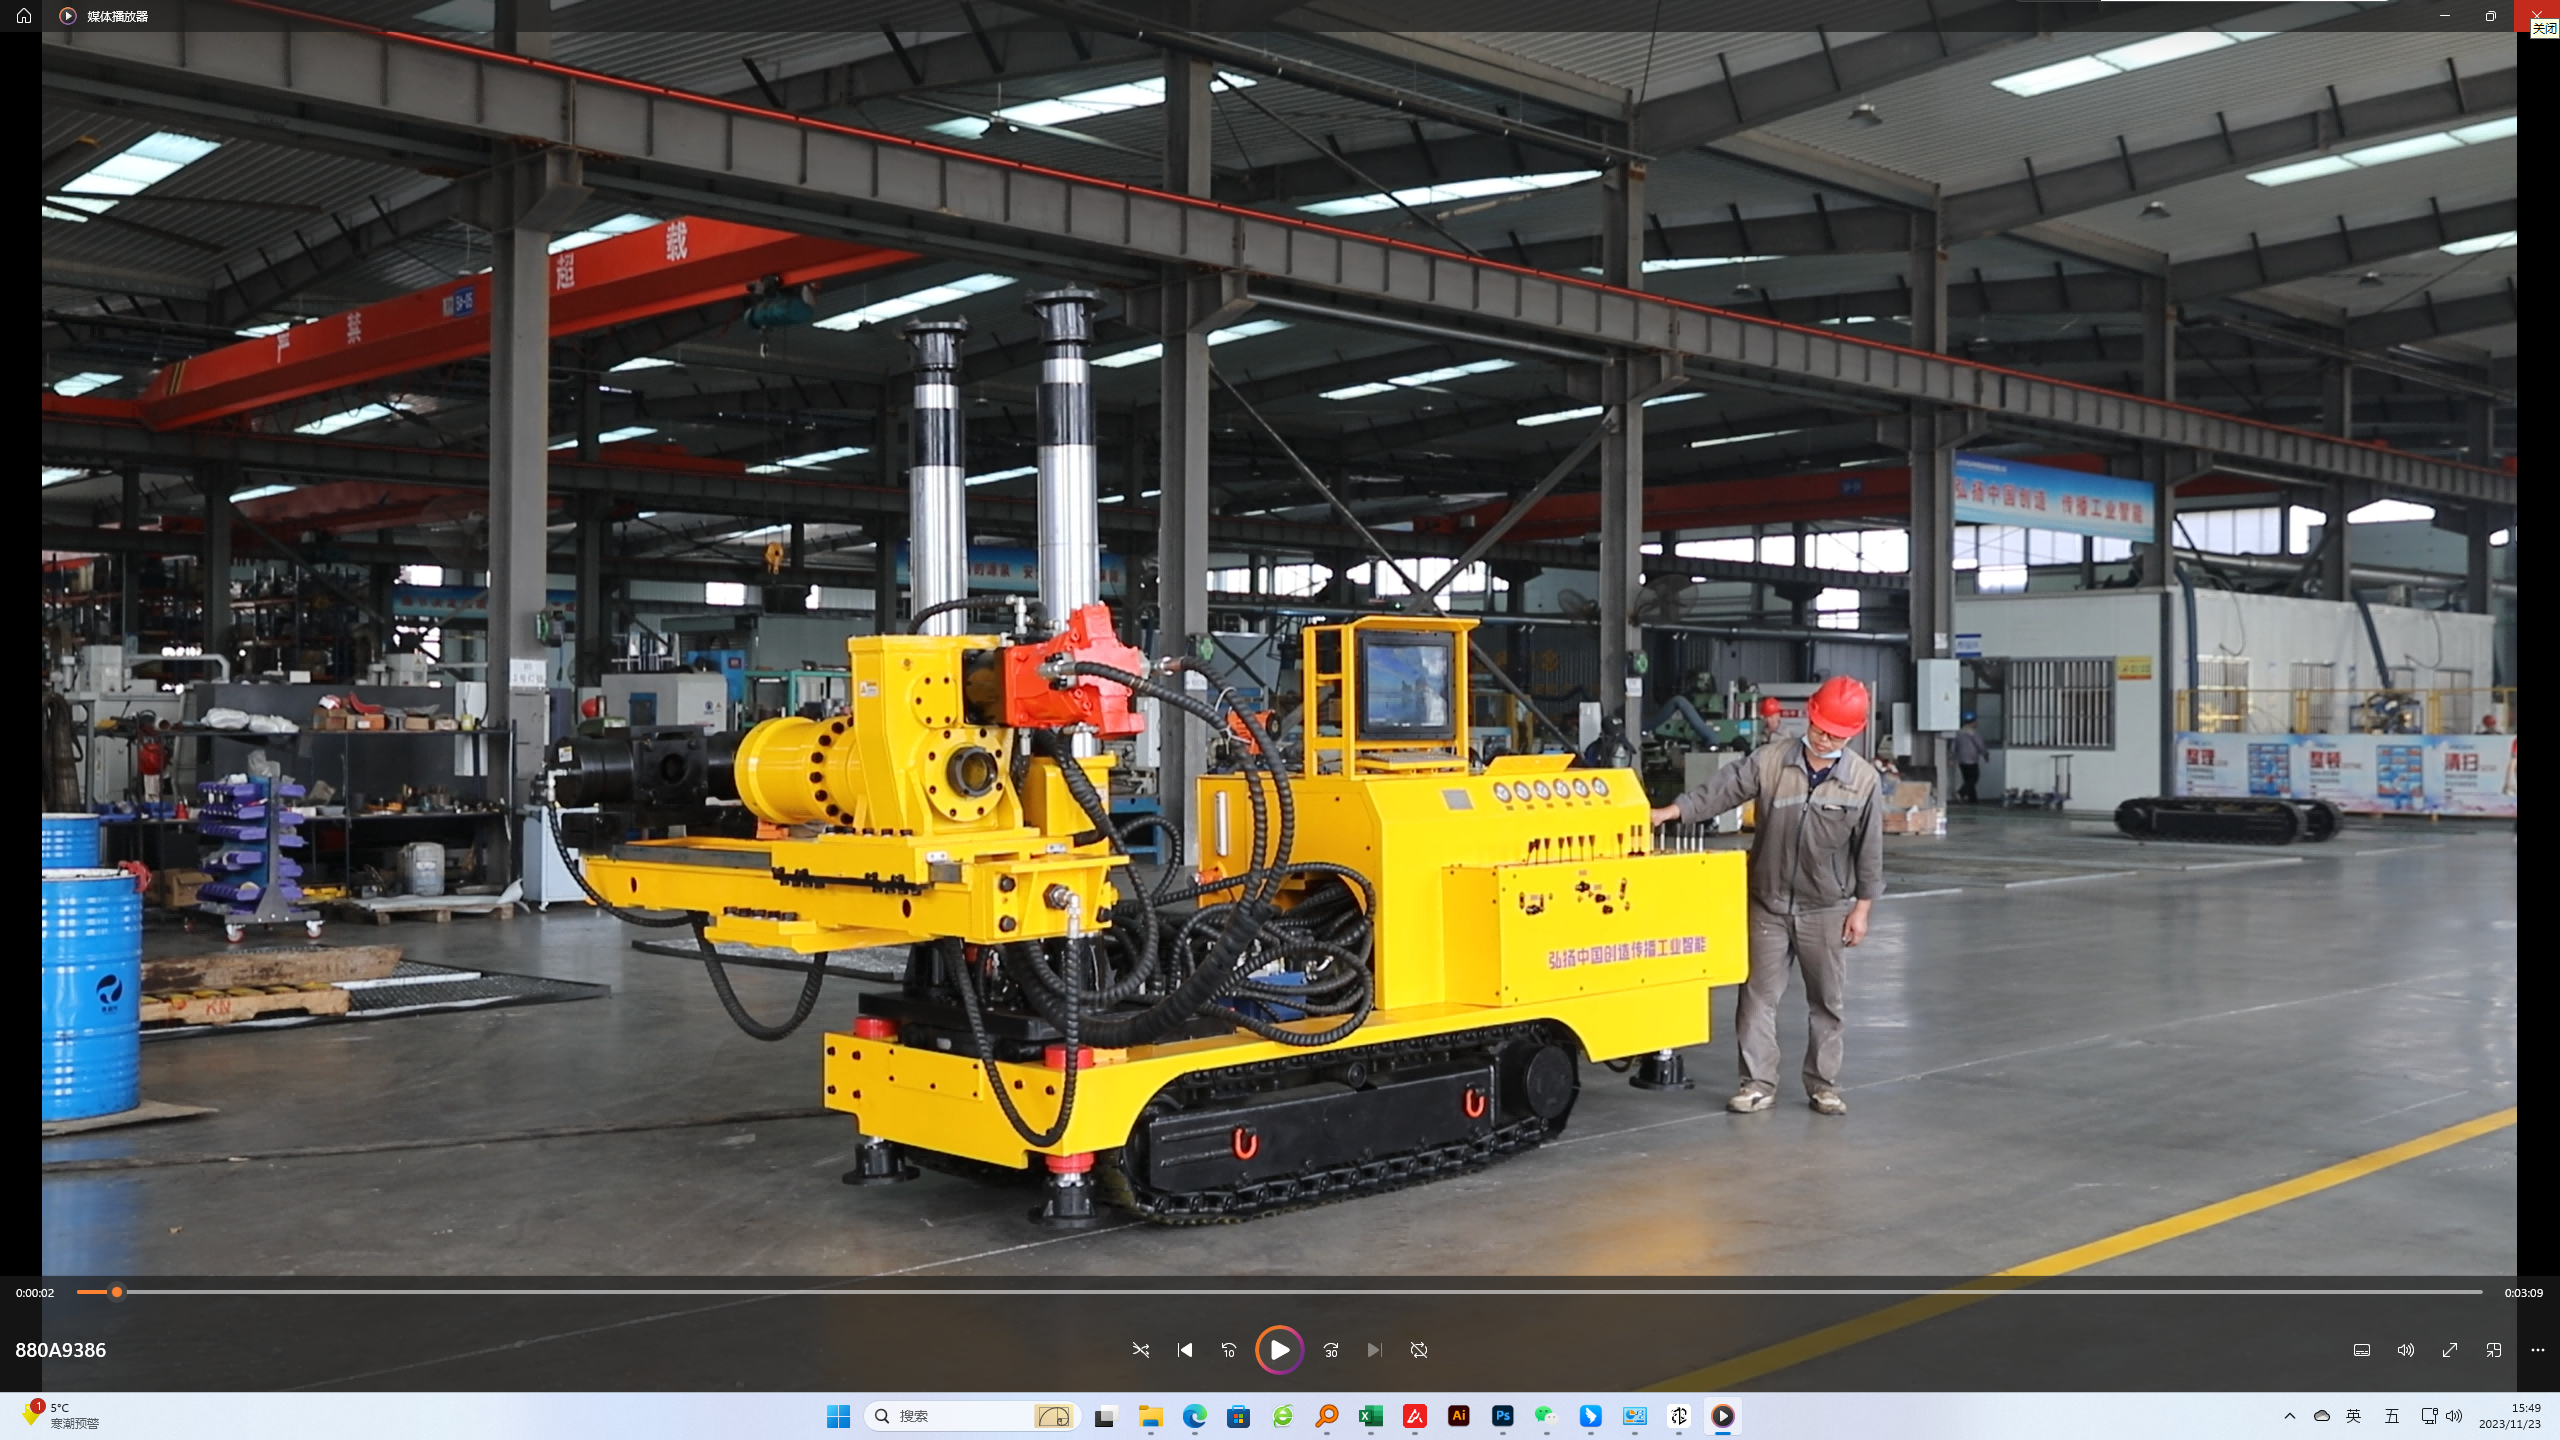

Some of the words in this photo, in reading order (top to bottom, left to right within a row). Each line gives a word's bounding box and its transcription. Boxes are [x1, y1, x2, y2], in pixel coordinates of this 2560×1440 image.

[555, 254, 574, 290] 超
[666, 220, 688, 262] 载
[2062, 493, 2144, 524] 传播工业智能
[1548, 935, 1706, 970] 弘扬中国创造传播工业智能
